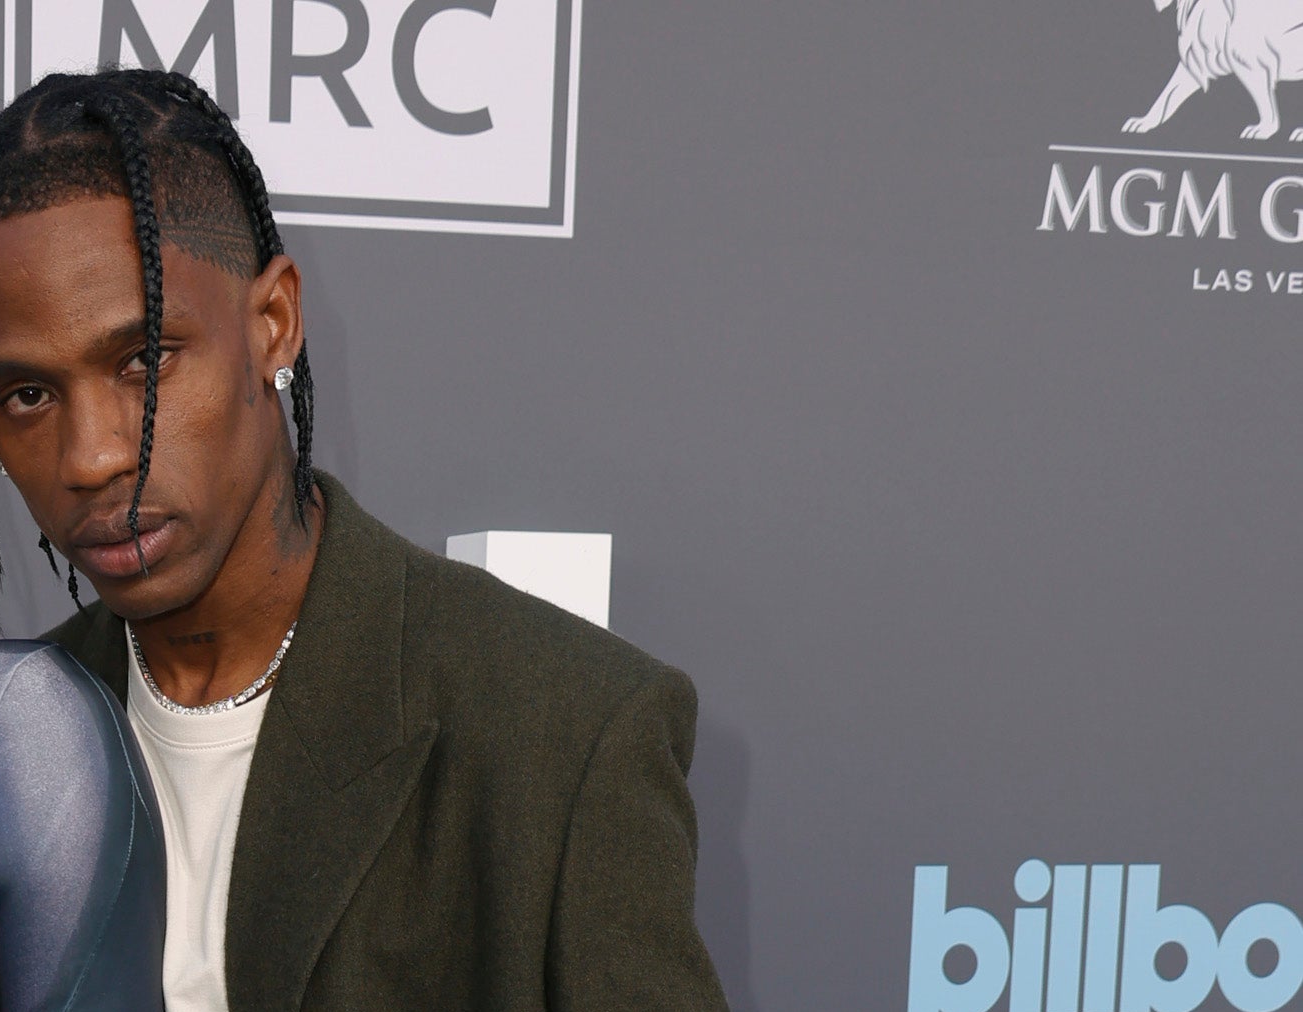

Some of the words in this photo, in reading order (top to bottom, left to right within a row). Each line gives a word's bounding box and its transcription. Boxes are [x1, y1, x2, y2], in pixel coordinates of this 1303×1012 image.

[97, 0, 497, 137] MRC
[1036, 162, 1238, 240] MGM
[1192, 267, 1253, 293] LAS
